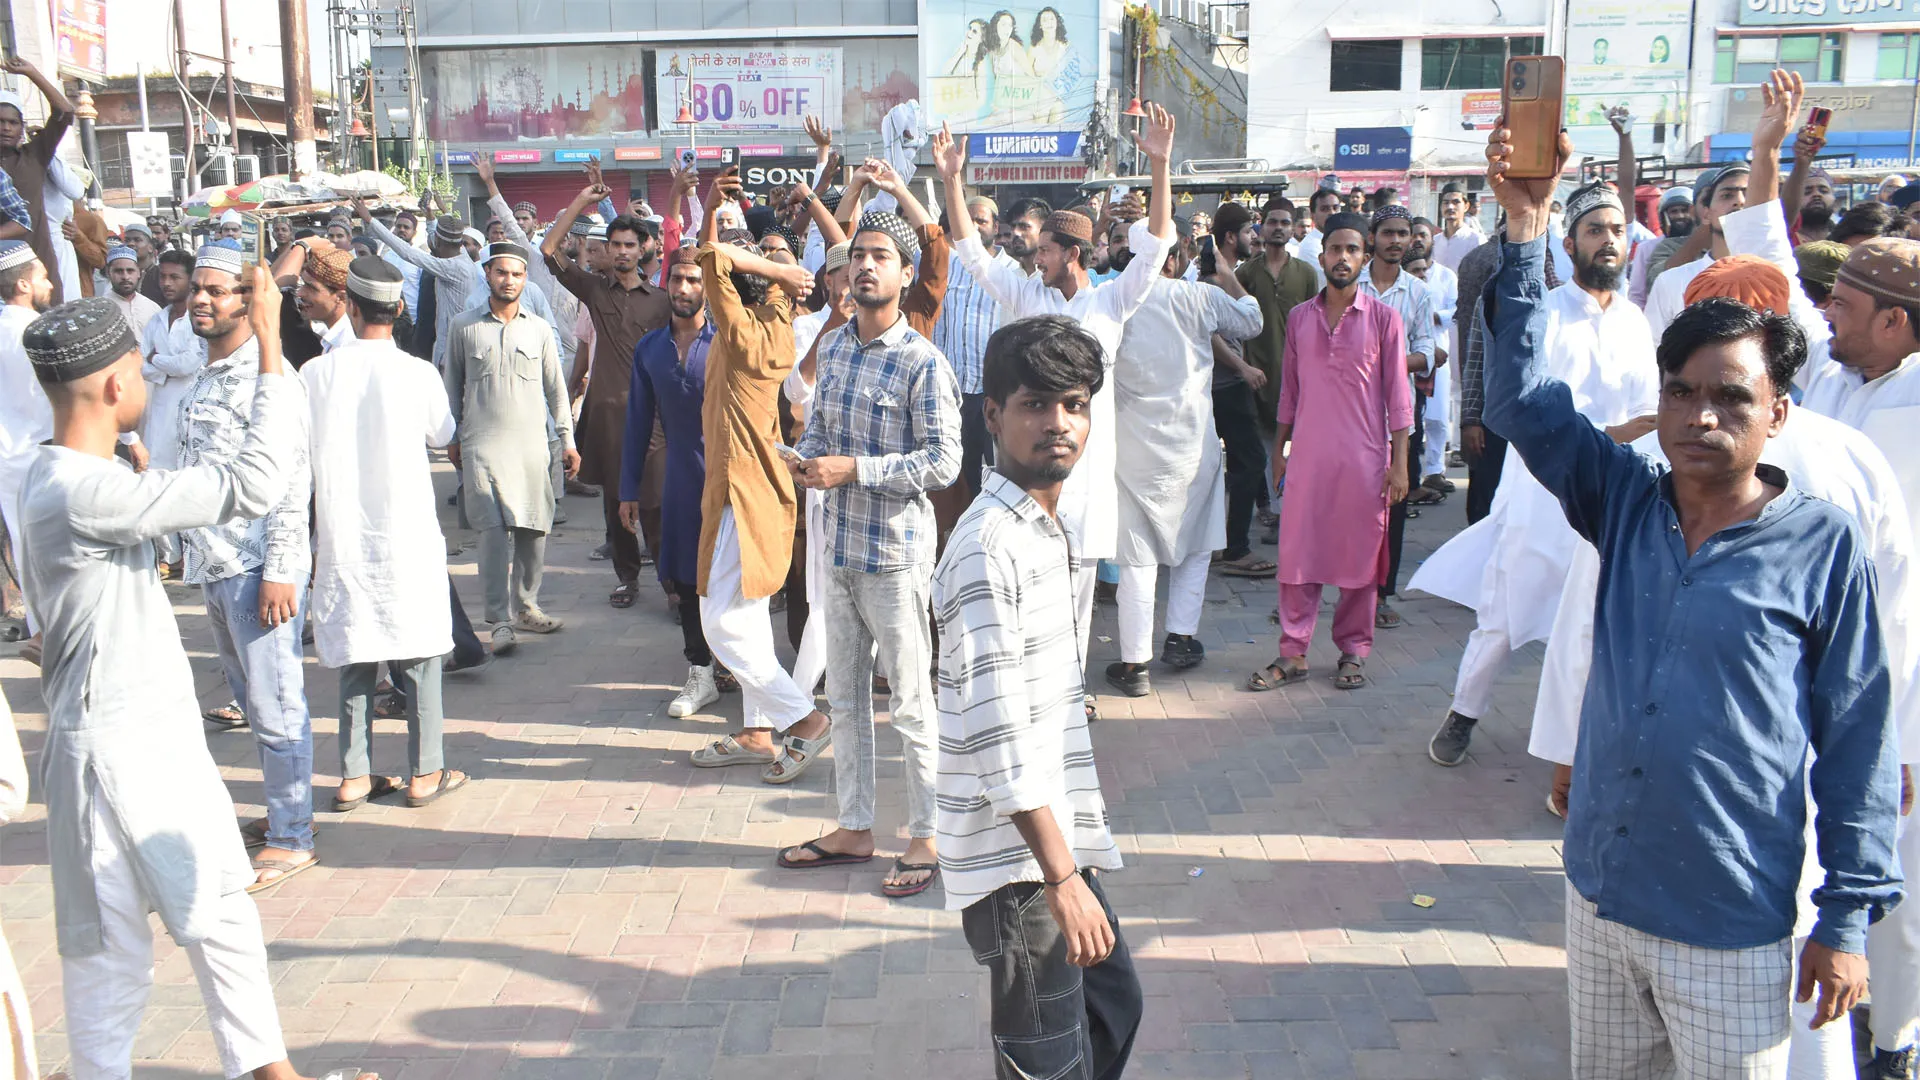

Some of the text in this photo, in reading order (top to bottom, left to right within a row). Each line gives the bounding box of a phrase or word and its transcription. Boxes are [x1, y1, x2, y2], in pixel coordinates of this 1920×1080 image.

[713, 53, 724, 66] के
[726, 54, 741, 66] रंग
[778, 53, 811, 66] के संग
[1001, 85, 1035, 100] NEW
[739, 99, 757, 119] %
[763, 87, 810, 116] OFF
[985, 135, 1059, 154] LUMINOUS
[1350, 144, 1370, 155] SBI
[1022, 166, 1062, 181] BATTERY
